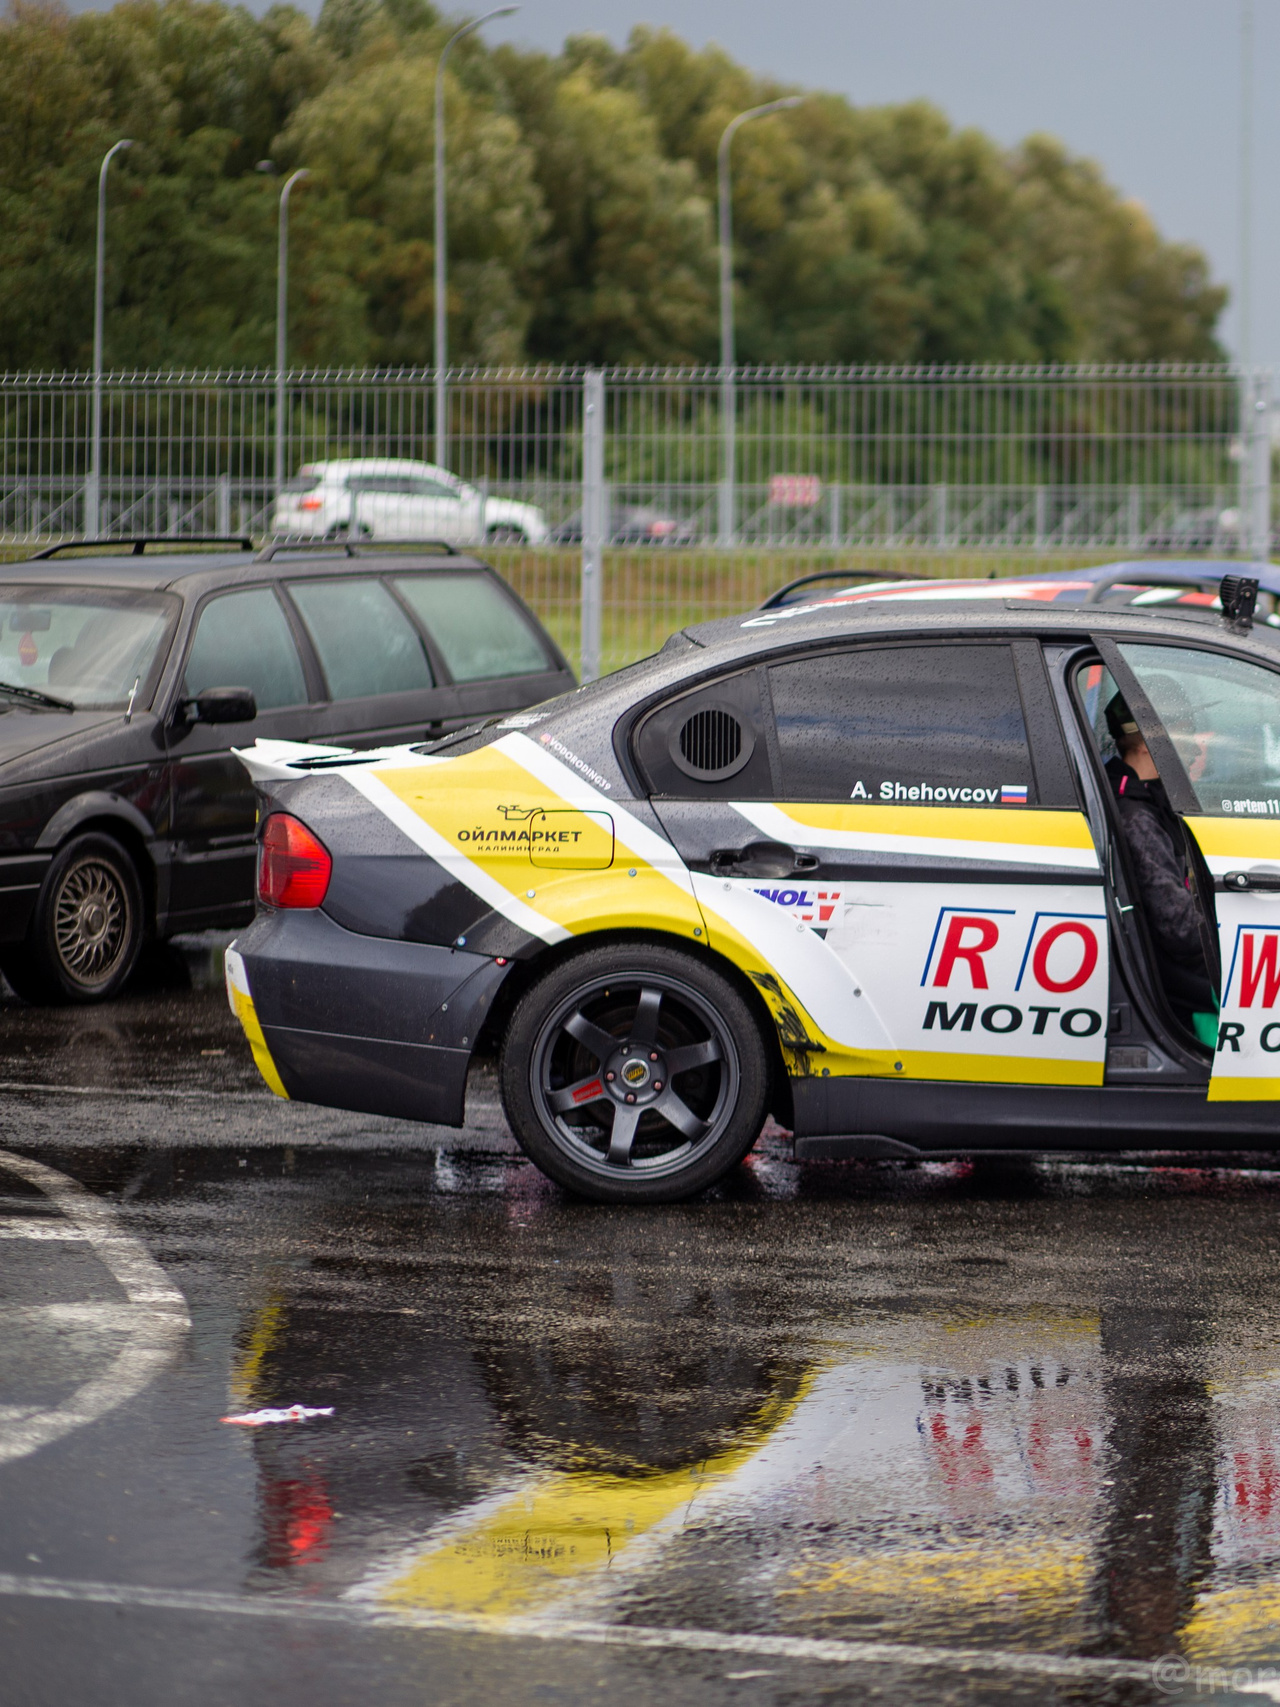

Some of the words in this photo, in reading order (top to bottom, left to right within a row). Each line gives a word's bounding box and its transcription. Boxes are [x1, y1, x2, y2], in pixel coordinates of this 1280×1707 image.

[549, 737, 612, 791] VODORODING39
[850, 780, 873, 799] A.
[879, 781, 999, 803] Shehovcov
[457, 826, 583, 843] ОЙЛМАРКЕТ
[477, 845, 560, 853] КАЛИНИНГРАД
